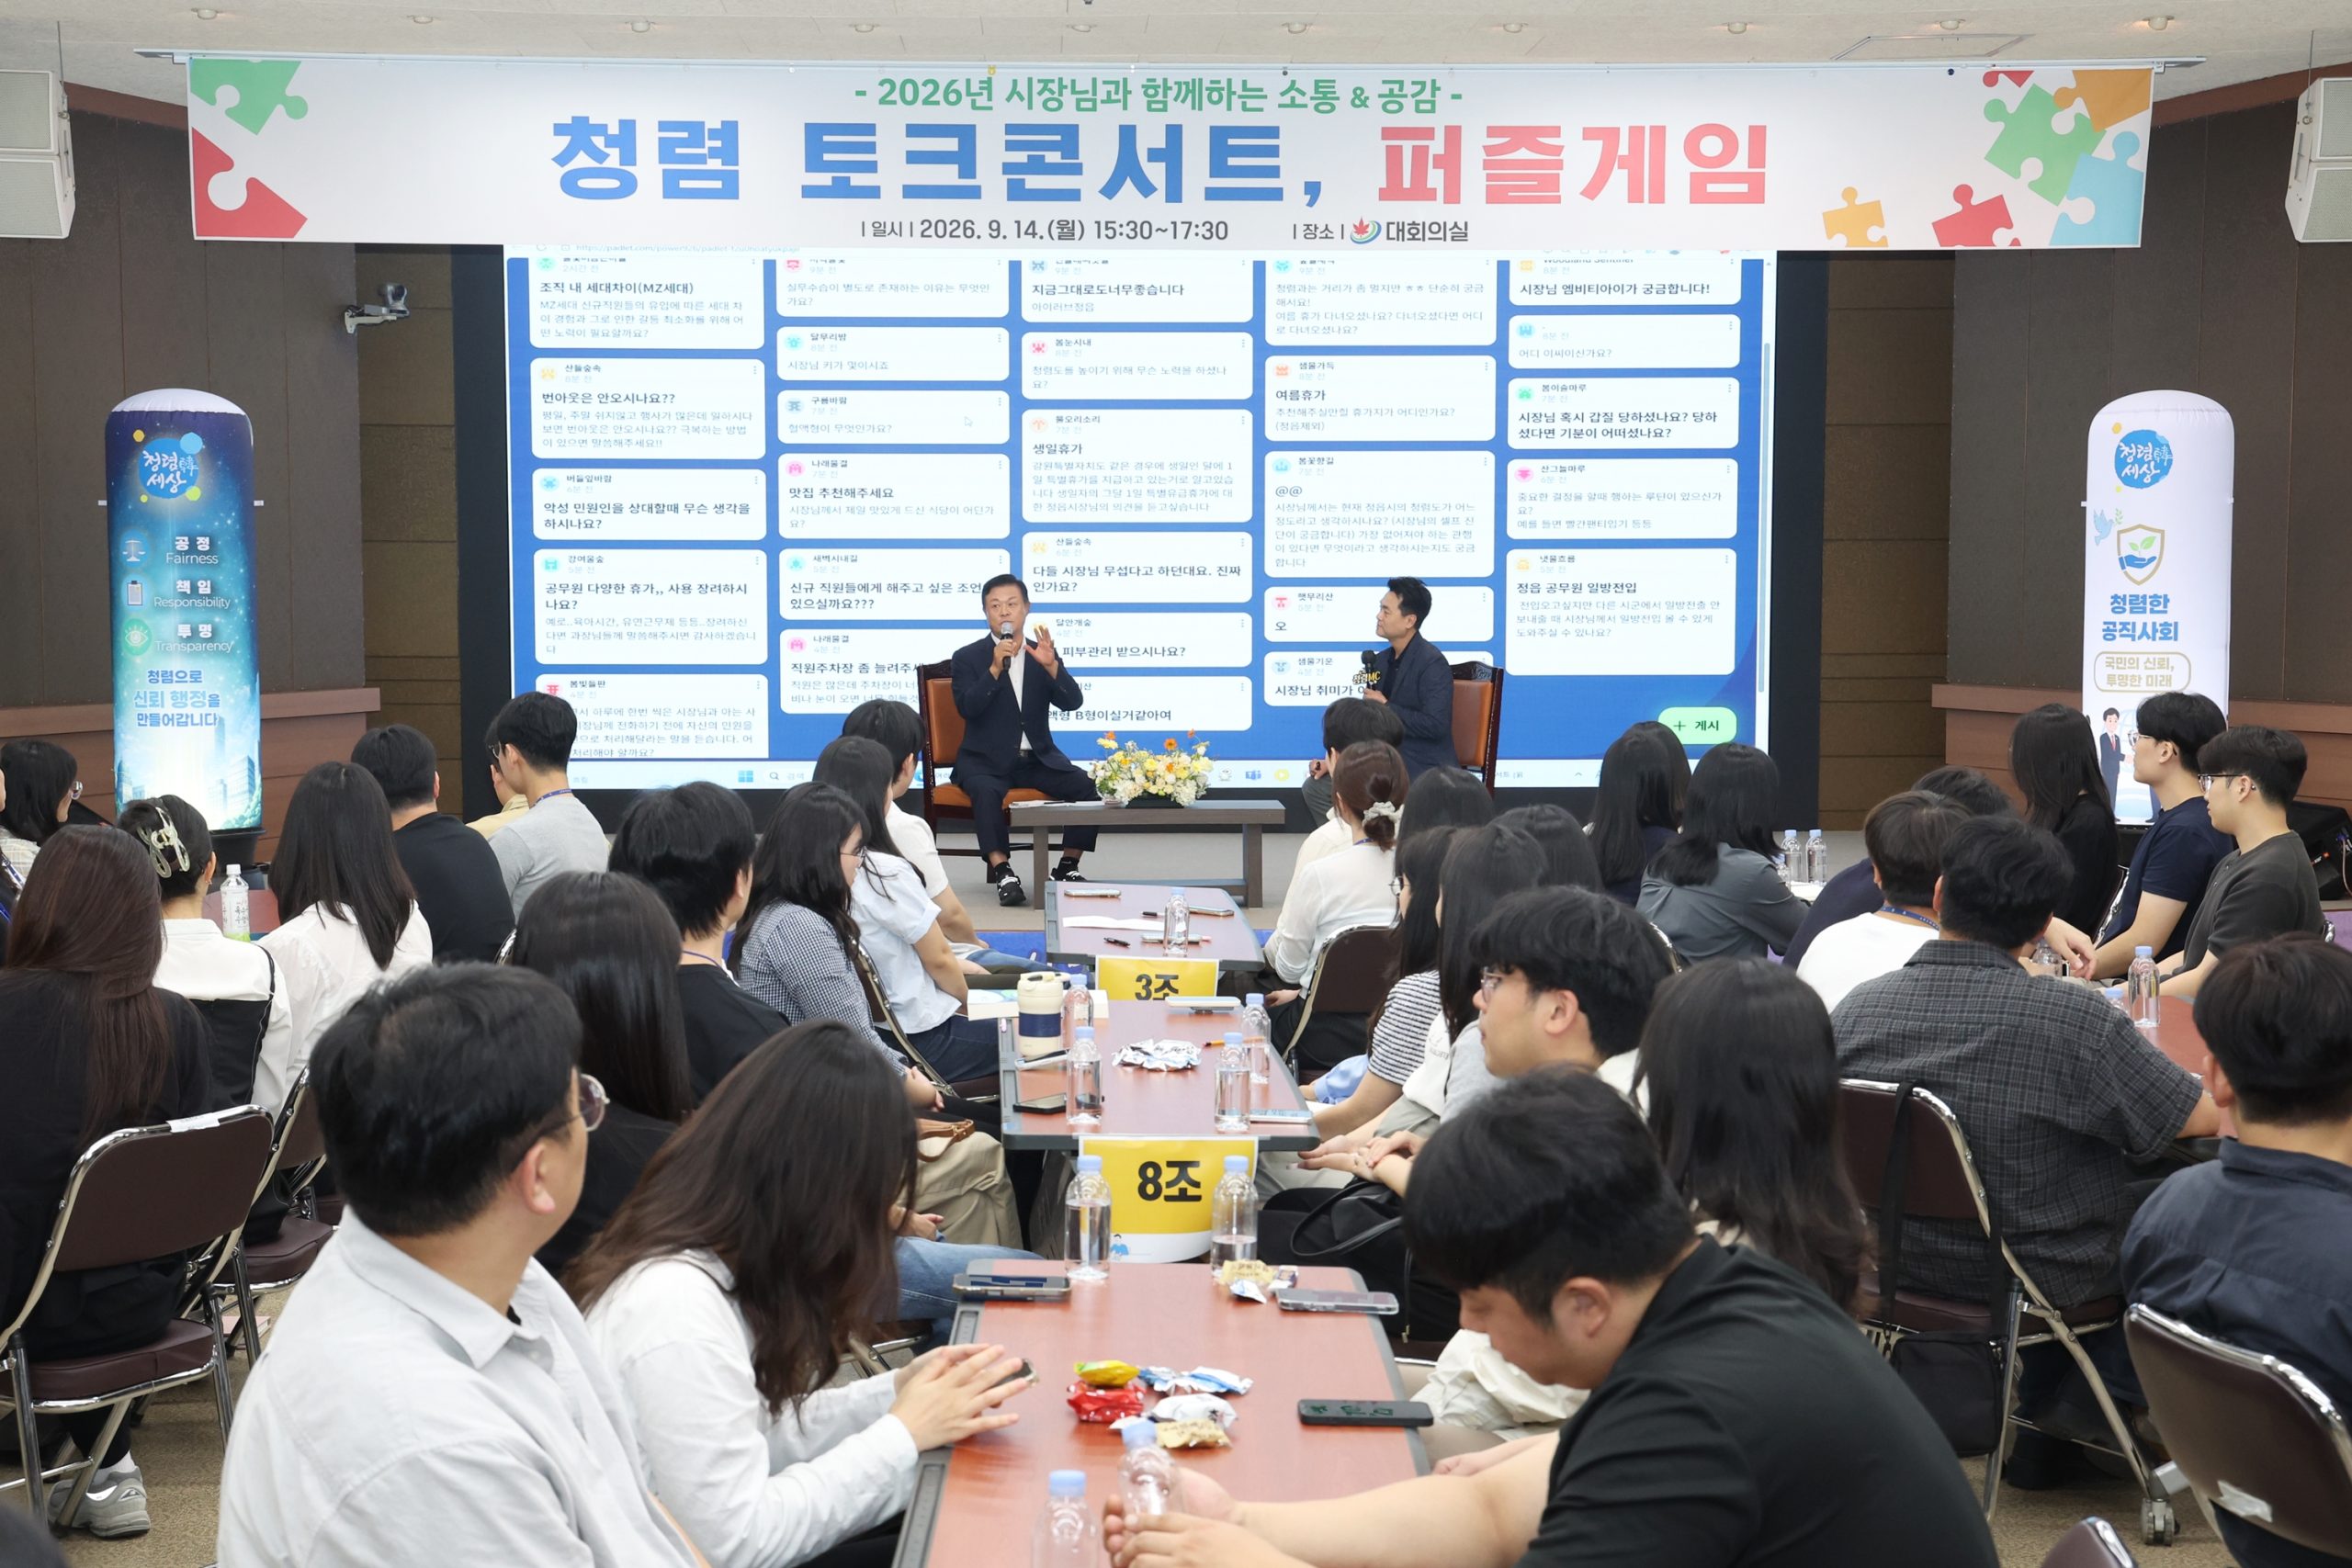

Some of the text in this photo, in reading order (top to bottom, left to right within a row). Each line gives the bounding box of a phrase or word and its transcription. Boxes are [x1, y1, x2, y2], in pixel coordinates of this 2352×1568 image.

[878, 76, 993, 111] 2026년
[1005, 76, 1132, 112] 시장님과
[1141, 77, 1268, 112] 함께하는
[1278, 79, 1340, 113] 소통
[1377, 78, 1441, 113] 공감
[551, 116, 1767, 208] 청렴 토크콘서트, 퍼즐게임
[872, 221, 902, 237] 일시
[921, 220, 981, 239] 2026.
[989, 220, 1007, 240] 9.
[1014, 220, 1084, 241] 14.(월)
[1094, 220, 1227, 240] 15:30~17:30
[1303, 224, 1334, 240] 장소
[1386, 220, 1468, 242] 대회의실
[539, 281, 694, 295] 조직 내 세대차이(MZ세대)
[1032, 283, 1185, 297] 지금그대로도너무좋습니다
[1520, 282, 1710, 296] 시장님 엠비티아이가 궁금합니다!
[539, 299, 578, 310] MZ세대
[581, 300, 645, 311] 신규직원들의
[648, 300, 681, 311] 유입에
[683, 300, 706, 311] 따른
[707, 300, 730, 311] 세대
[1031, 301, 1096, 313] 아이러브정읍
[1275, 310, 1483, 322] 여름 휴가 다녀오셨나요? 다녀오셨다면 어디
[1274, 324, 1359, 335] 로 다녀오셨나요?
[1518, 348, 1540, 359] 어디
[786, 359, 889, 371] 시장님 키가 몇이시죠
[541, 391, 676, 405] 번아웃은 안오시나요??
[1275, 389, 1327, 401] 여름휴가
[1518, 411, 1718, 423] 시장님 혹시 갑질 당하셨나요? 당하
[833, 423, 893, 434] 무엇인가요?
[1518, 427, 1672, 440] 셨다면 기분이 어떠셨나요?
[1032, 443, 1083, 456] 생일휴가
[2121, 461, 2160, 483] 세상
[147, 471, 187, 493] 세상
[788, 487, 895, 500] 맛집 추천해주세요
[1274, 485, 1303, 498] @@
[543, 502, 751, 515] 악성 민원인을 상대할때 무슨 생각을
[788, 504, 995, 516] 시장님께서 제일 맛있게 드신 식당이 어딘가
[543, 518, 603, 530] 하시나요?
[788, 518, 807, 530] 요?
[166, 552, 219, 565] Fairness
[1033, 565, 1241, 578] 다들 시장님 무섭다고 하던대요. 진짜
[545, 582, 748, 596] 공무원 다양한 휴가,, 사용 장려하시
[790, 581, 816, 594] 신규
[819, 581, 882, 594] 직원들에게
[886, 582, 924, 594] 해주고
[928, 581, 954, 594] 싶은
[1033, 581, 1079, 593] 인가요?
[1516, 581, 1637, 594] 정읍 공무원 일방전입
[153, 597, 231, 610] Responsibility
[545, 598, 578, 611] 나요?
[790, 597, 875, 611] 있으실까요???
[2109, 593, 2170, 615] 청렴한
[1274, 621, 1287, 632] 오
[1516, 627, 1612, 638] 도와주실 수 있나요?
[2102, 621, 2179, 642] 공직사회
[154, 640, 233, 654] Transparency
[1061, 646, 1186, 659] 피부관리 받으시나요?
[790, 662, 854, 674] 직원주차장
[857, 662, 871, 674] 좀
[2105, 656, 2175, 671] 국민의 신뢰,
[147, 670, 202, 684] 청렴으로
[2106, 674, 2173, 688] 투명한 미래
[1274, 684, 1353, 697] 시장님 취미가
[134, 690, 220, 709] 신뢰 행정을
[137, 713, 218, 728] 만들어갑니다
[1075, 710, 1171, 723] B형이실거같아여
[1694, 719, 1720, 732] 게시
[1135, 974, 1180, 1000] 3조
[1137, 1160, 1203, 1202] 8조
